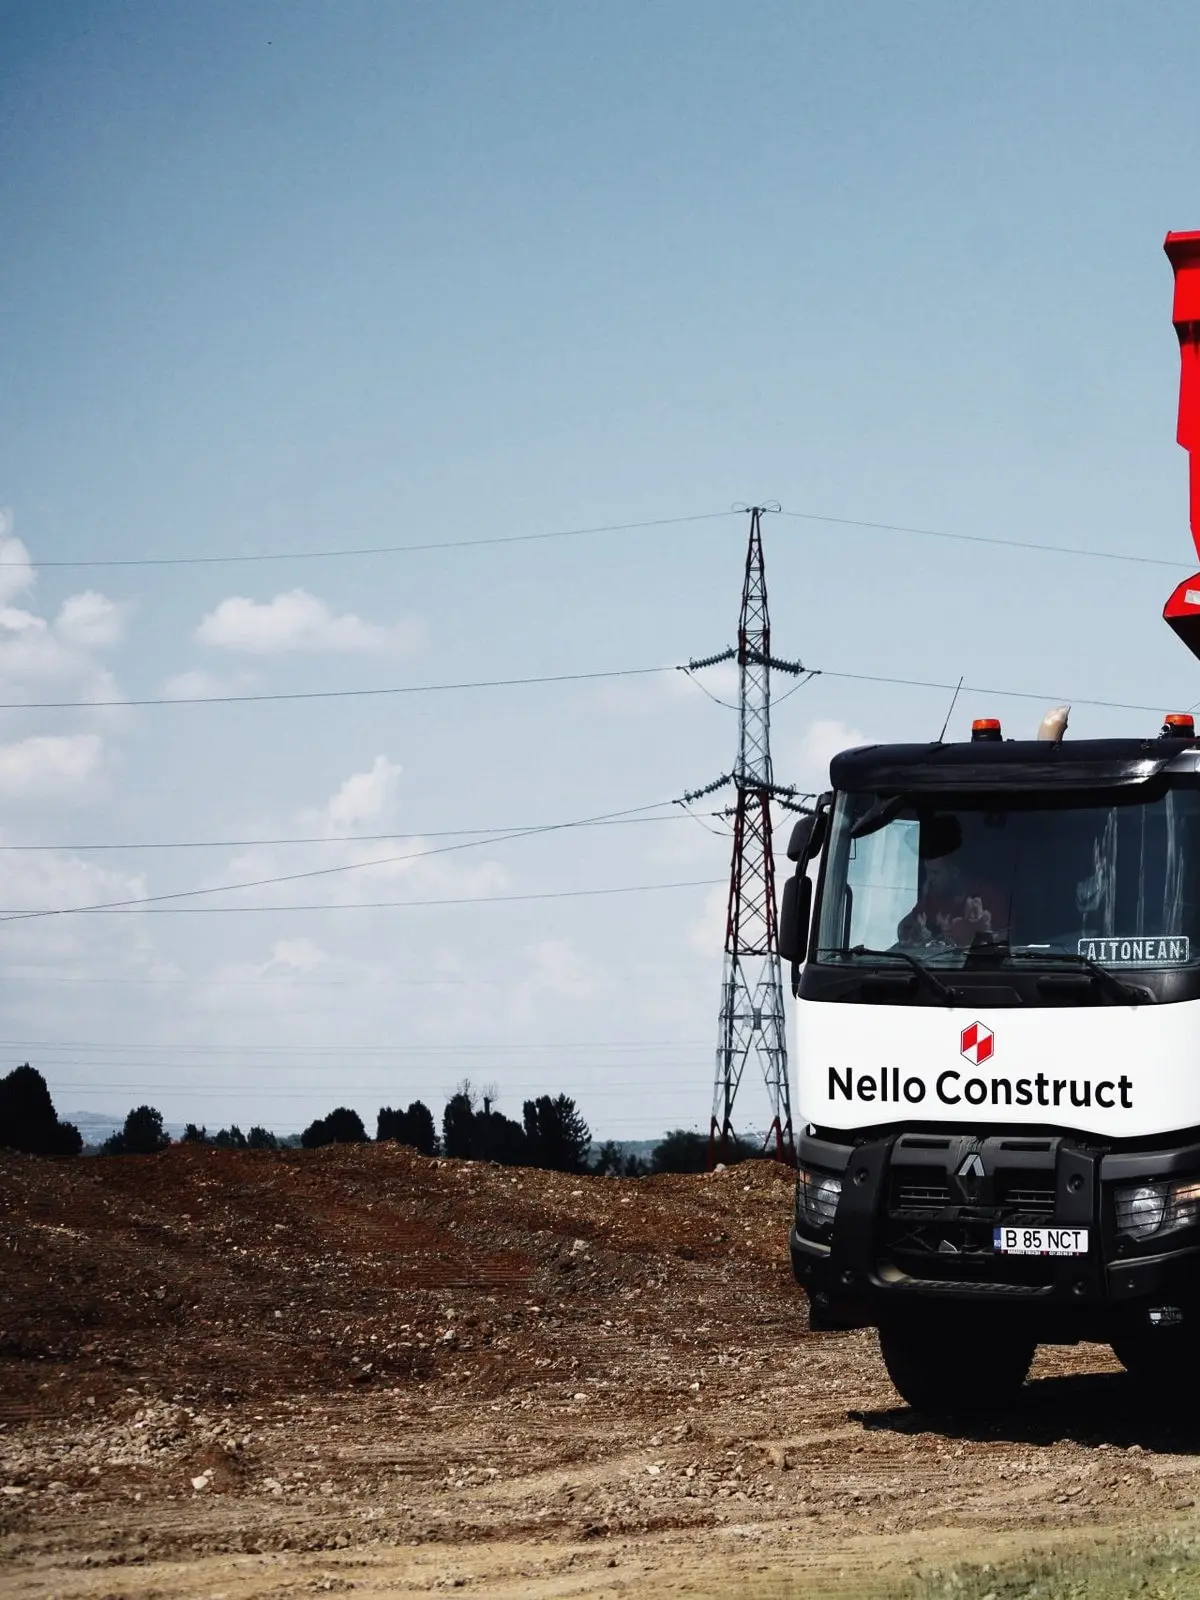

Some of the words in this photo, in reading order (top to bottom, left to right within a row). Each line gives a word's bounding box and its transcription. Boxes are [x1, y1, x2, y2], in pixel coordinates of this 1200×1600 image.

[1087, 940, 1180, 960] AITONEAN
[828, 1066, 926, 1104] Nello
[935, 1070, 1133, 1109] Construct
[1005, 1229, 1017, 1248] B
[1023, 1230, 1042, 1248] 85
[1047, 1230, 1081, 1249] NCT
